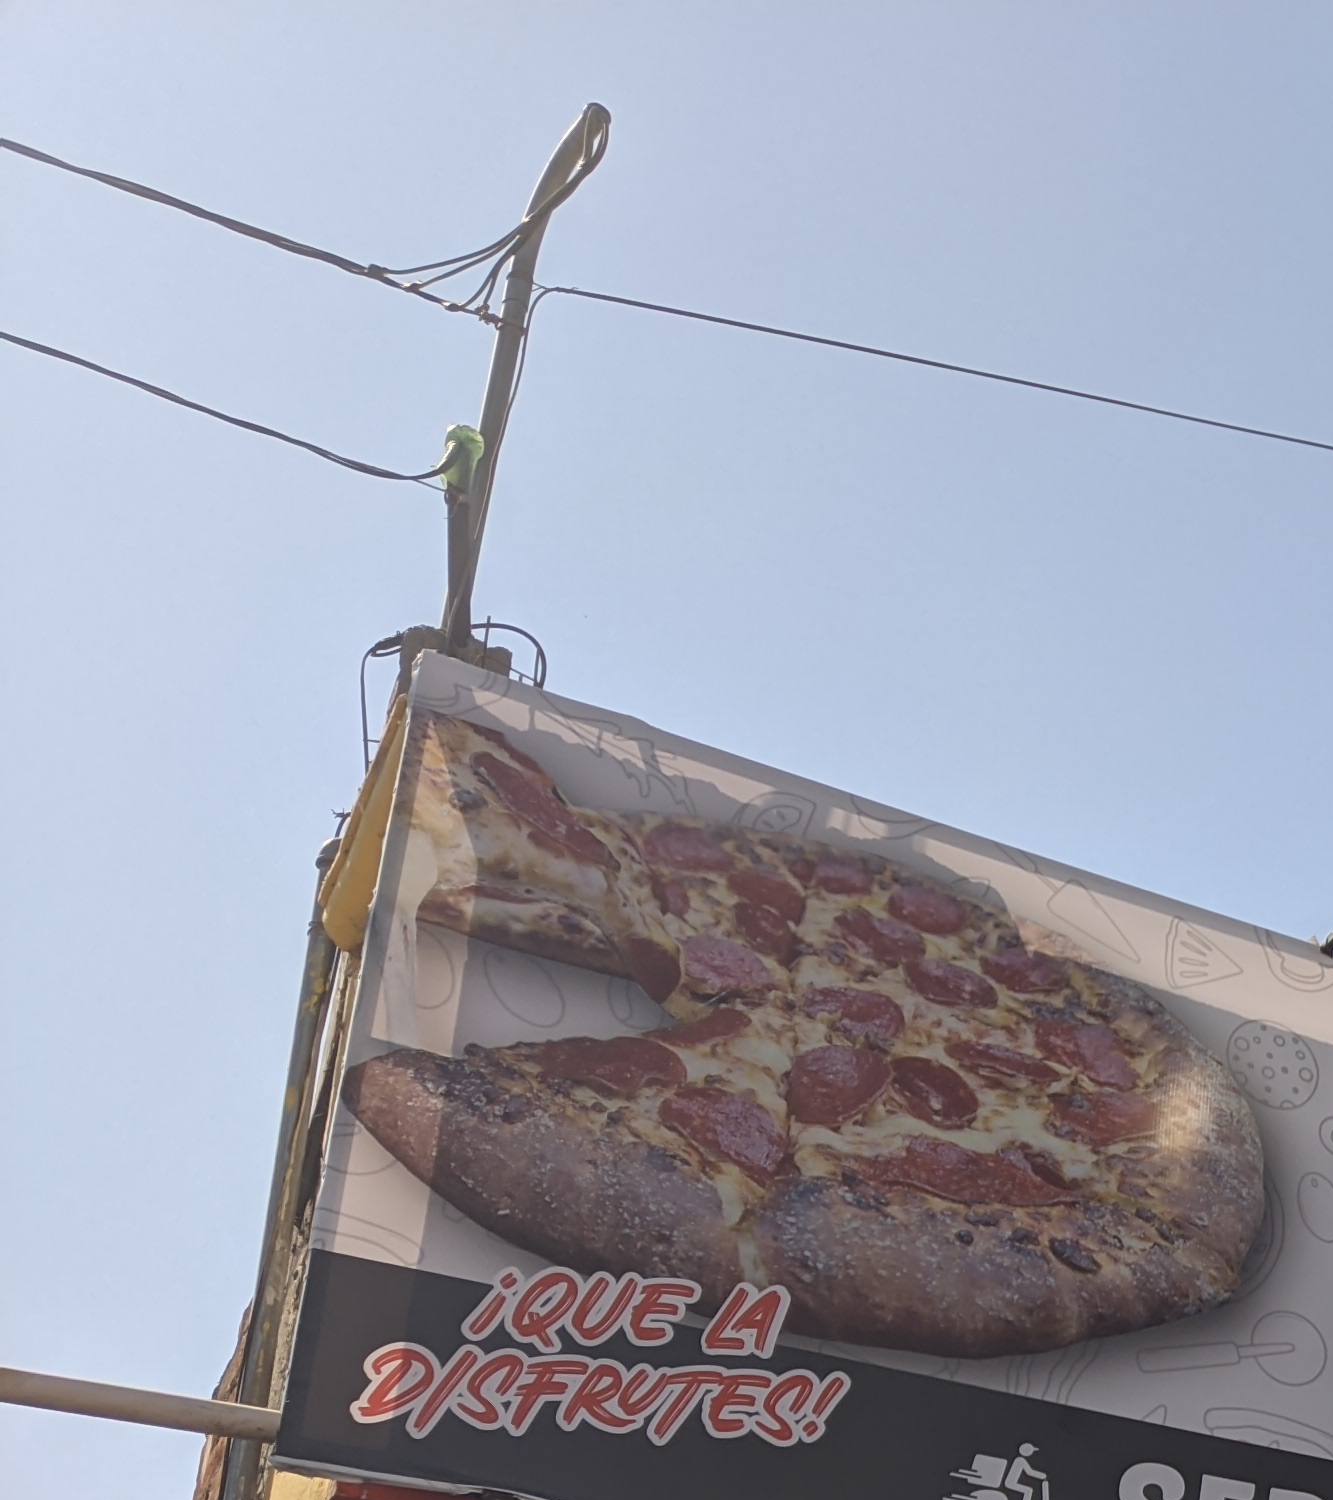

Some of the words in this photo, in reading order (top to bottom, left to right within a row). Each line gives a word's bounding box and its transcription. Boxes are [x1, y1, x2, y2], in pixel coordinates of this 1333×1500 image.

[468, 1271, 696, 1348] ¡QUE
[704, 1288, 783, 1354] LA
[357, 1347, 846, 1442] DISFRUTES!
